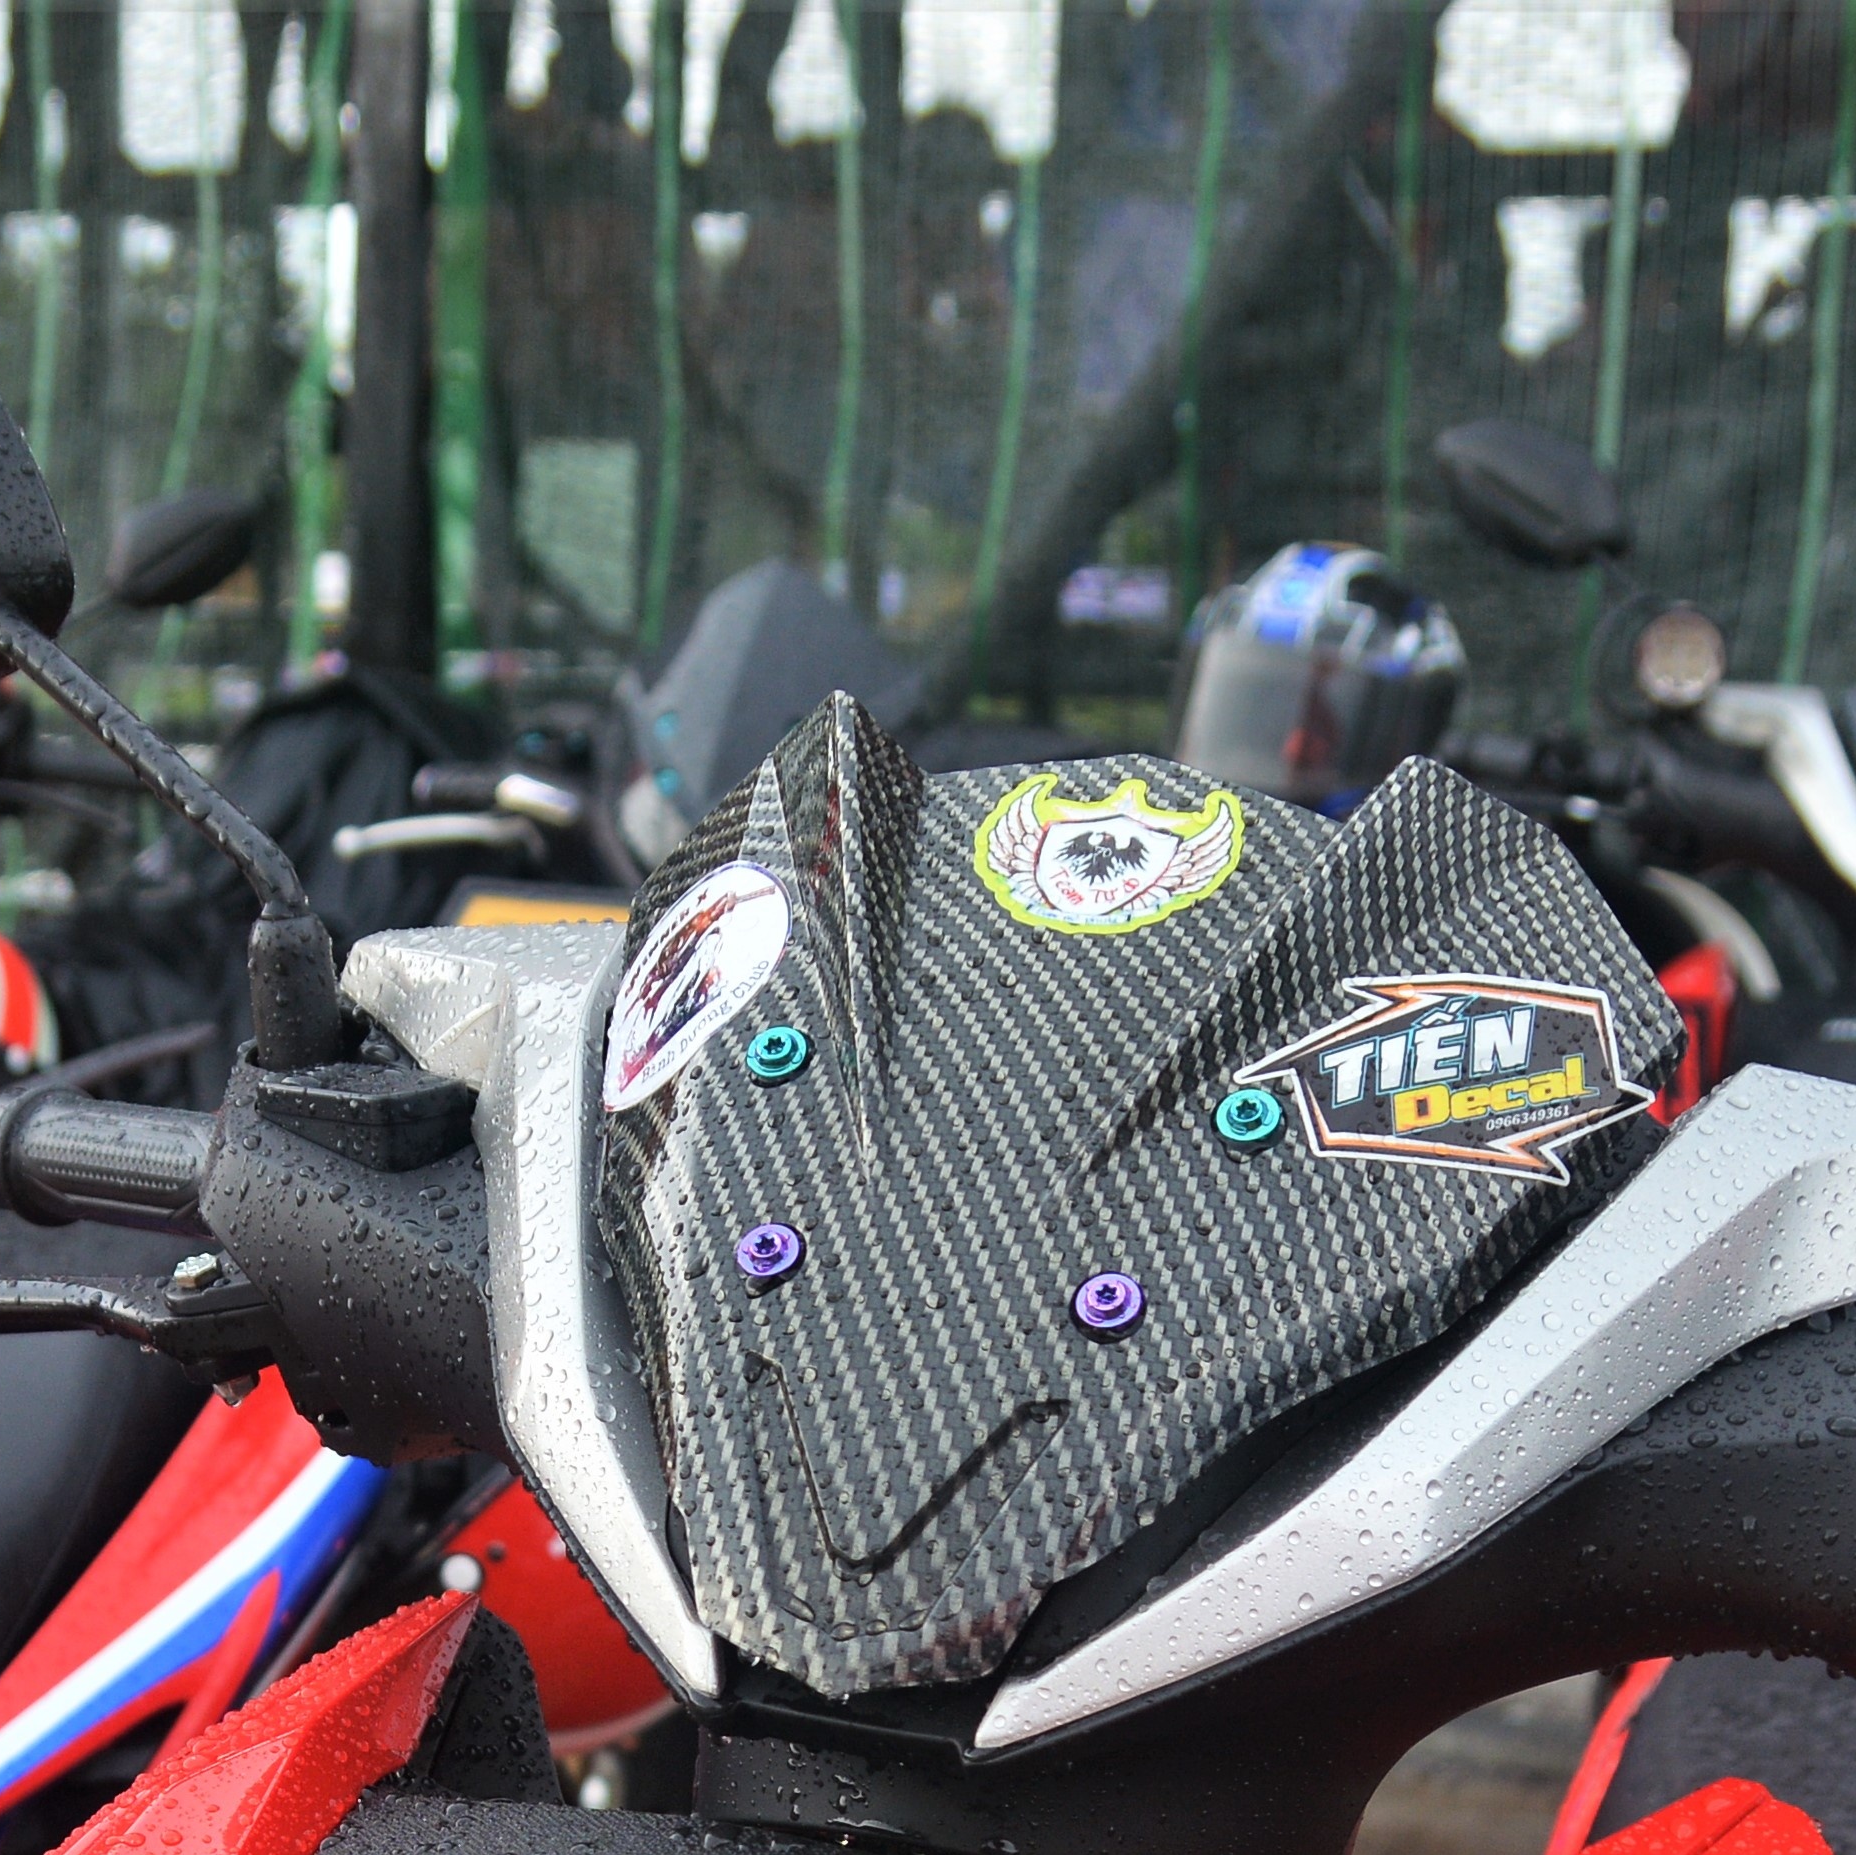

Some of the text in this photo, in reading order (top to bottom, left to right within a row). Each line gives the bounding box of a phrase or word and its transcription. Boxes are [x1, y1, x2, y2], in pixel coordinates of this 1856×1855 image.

[732, 959, 770, 999] Club
[1320, 993, 1537, 1108] TIẾN
[1392, 1053, 1600, 1136] Decal
[1486, 1105, 1570, 1131] 0966349361
